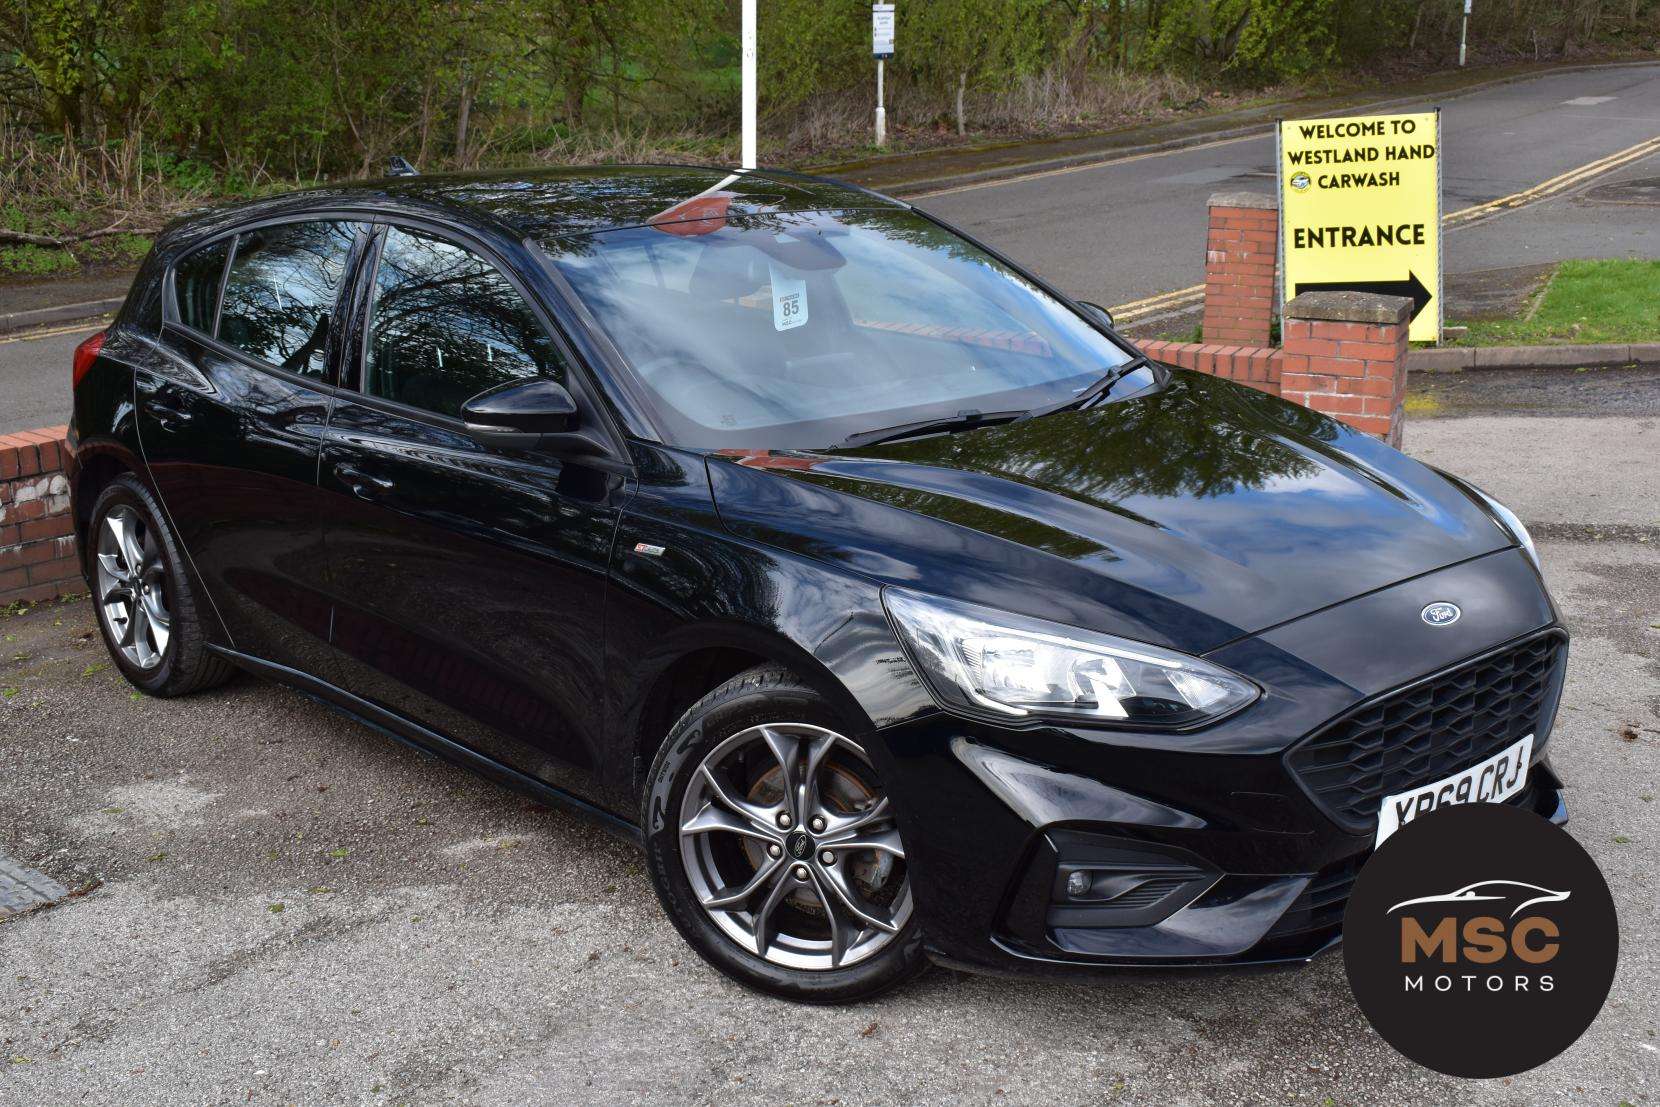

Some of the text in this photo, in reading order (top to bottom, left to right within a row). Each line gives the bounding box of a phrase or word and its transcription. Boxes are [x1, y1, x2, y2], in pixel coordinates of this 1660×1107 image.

[1299, 120, 1416, 139] WELCOME TO
[1288, 144, 1435, 166] WESTLAND HAND
[1318, 172, 1400, 189] CARWASH
[1294, 224, 1425, 249] ENTRANCE
[783, 300, 799, 316] 85
[1477, 746, 1523, 801] CRJ
